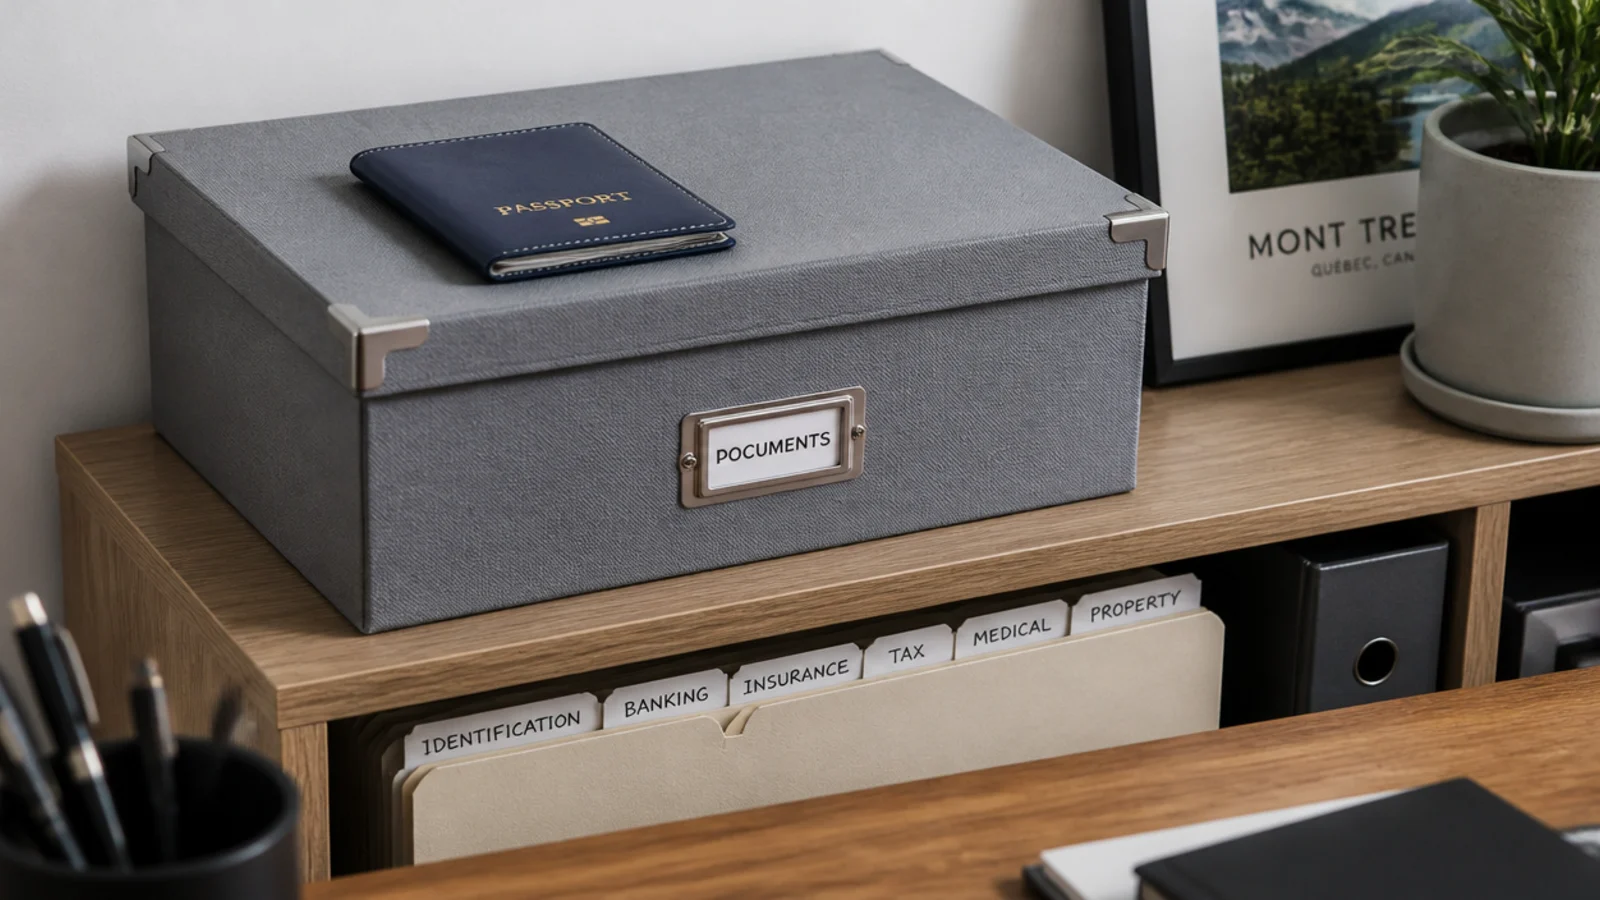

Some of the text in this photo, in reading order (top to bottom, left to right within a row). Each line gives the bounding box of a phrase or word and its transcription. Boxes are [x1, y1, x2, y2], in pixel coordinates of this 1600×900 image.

[494, 191, 632, 216] PASSPORT
[1248, 221, 1345, 260] MONT
[716, 431, 831, 464] POCUMENTS
[1090, 589, 1182, 622] PROPERTY
[973, 618, 1052, 647] MEDICAL
[888, 644, 925, 664] TAX
[743, 659, 850, 695] INSURANCE
[625, 686, 709, 718] BANKING
[422, 710, 581, 756] IDENTIFICATION
